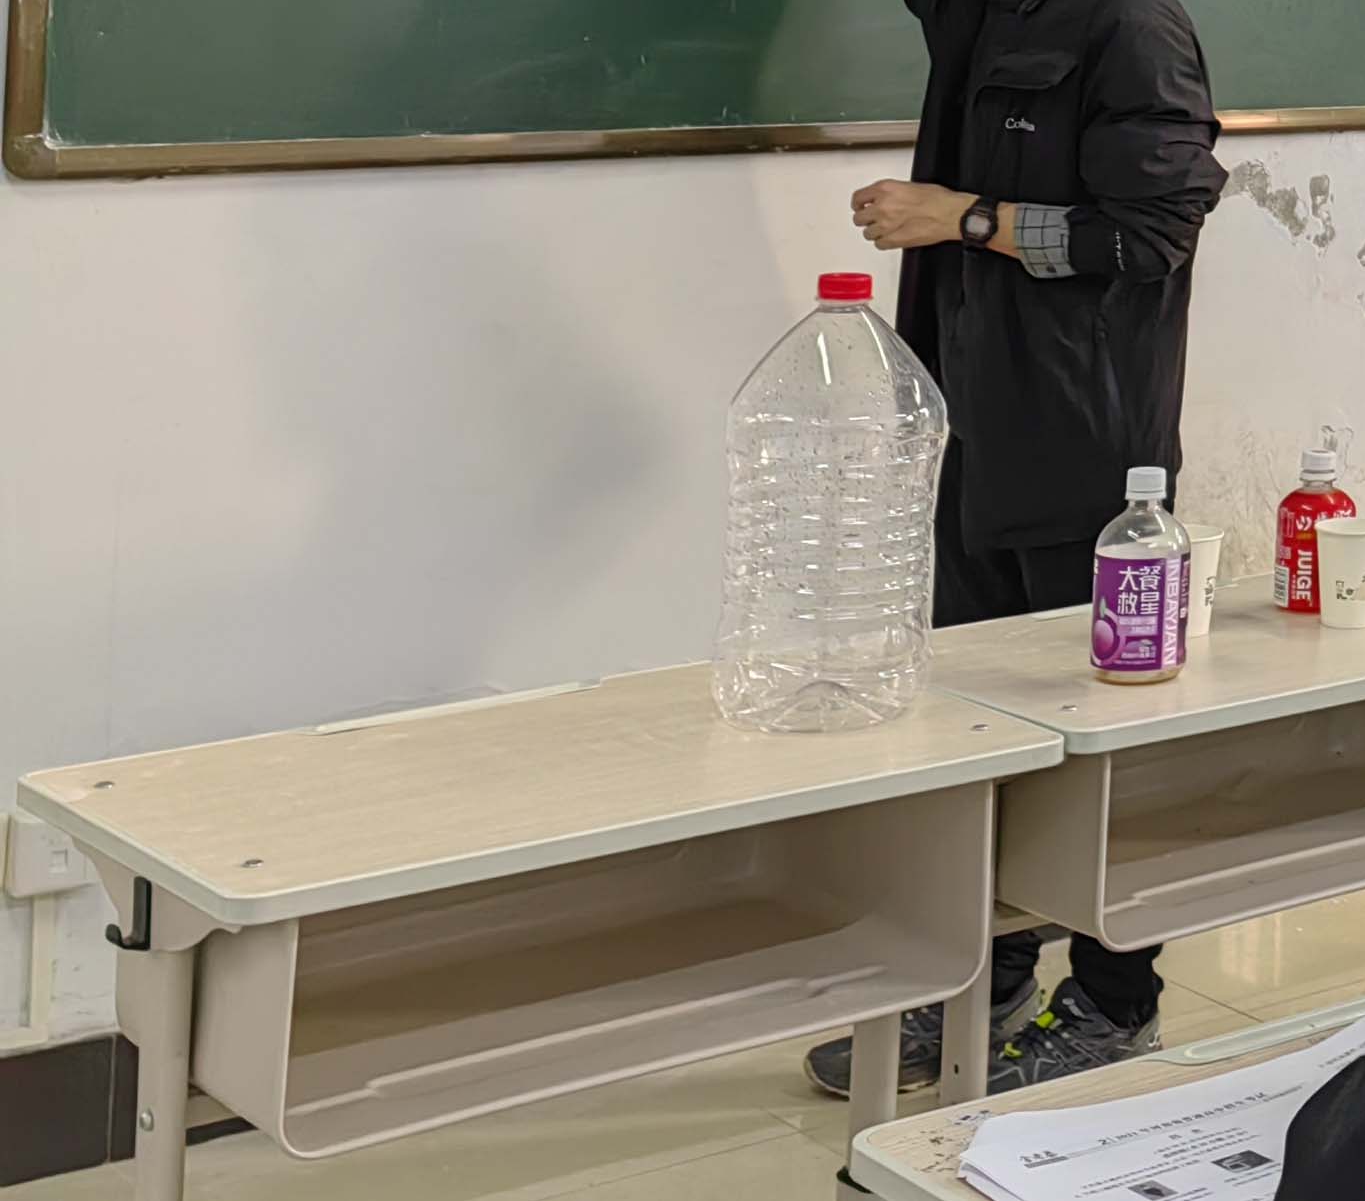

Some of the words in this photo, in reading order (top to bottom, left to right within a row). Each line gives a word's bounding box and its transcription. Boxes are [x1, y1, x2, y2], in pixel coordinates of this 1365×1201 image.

[1118, 565, 1162, 591] 大餐
[1296, 549, 1313, 601] JUIGE
[1117, 591, 1160, 616] 救星
